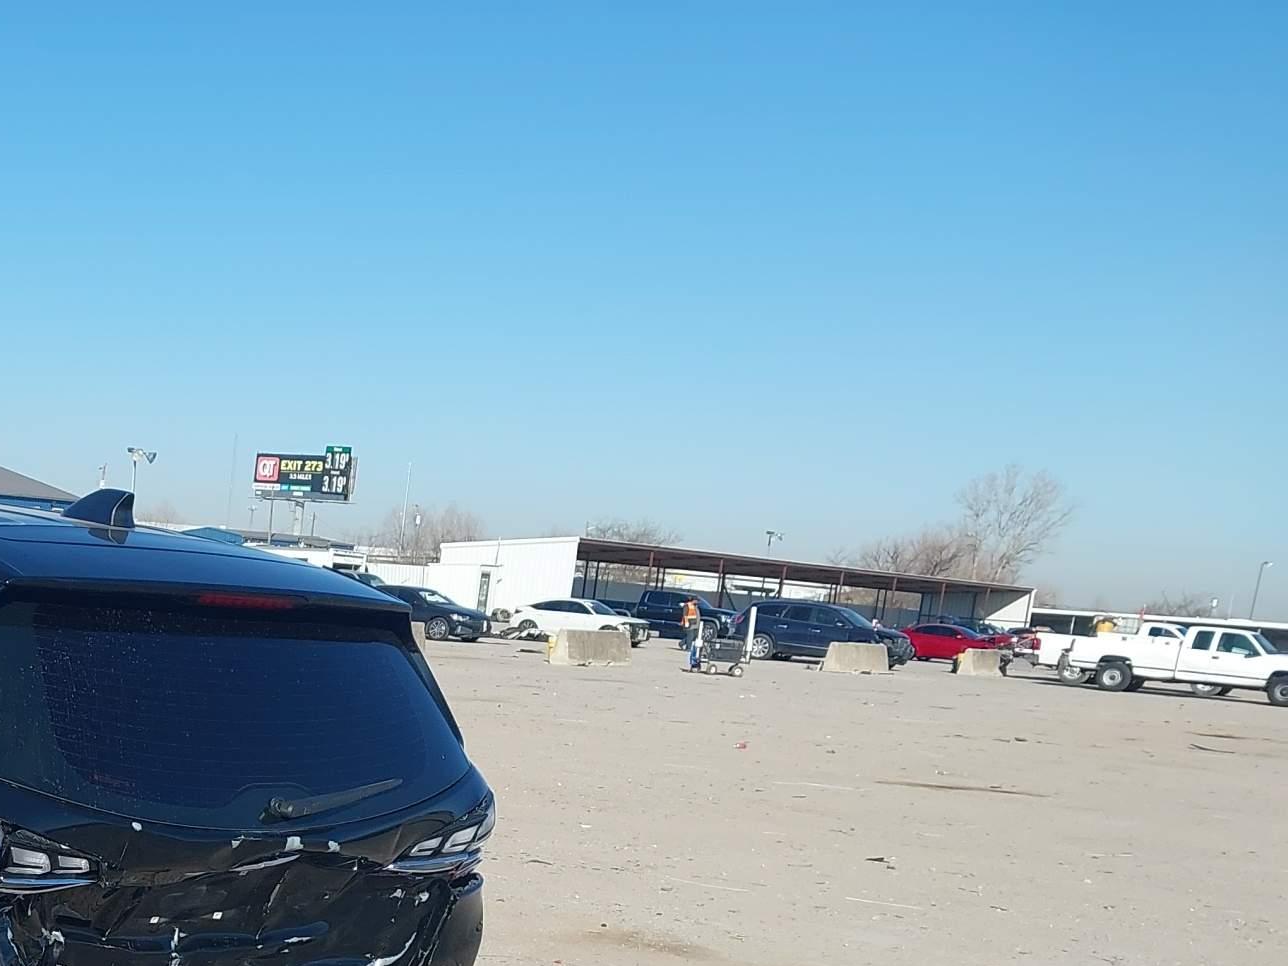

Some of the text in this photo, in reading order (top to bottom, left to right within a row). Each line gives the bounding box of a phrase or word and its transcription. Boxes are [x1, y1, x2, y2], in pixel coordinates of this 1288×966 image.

[260, 460, 276, 477] QT
[280, 460, 323, 471] EXIT 273
